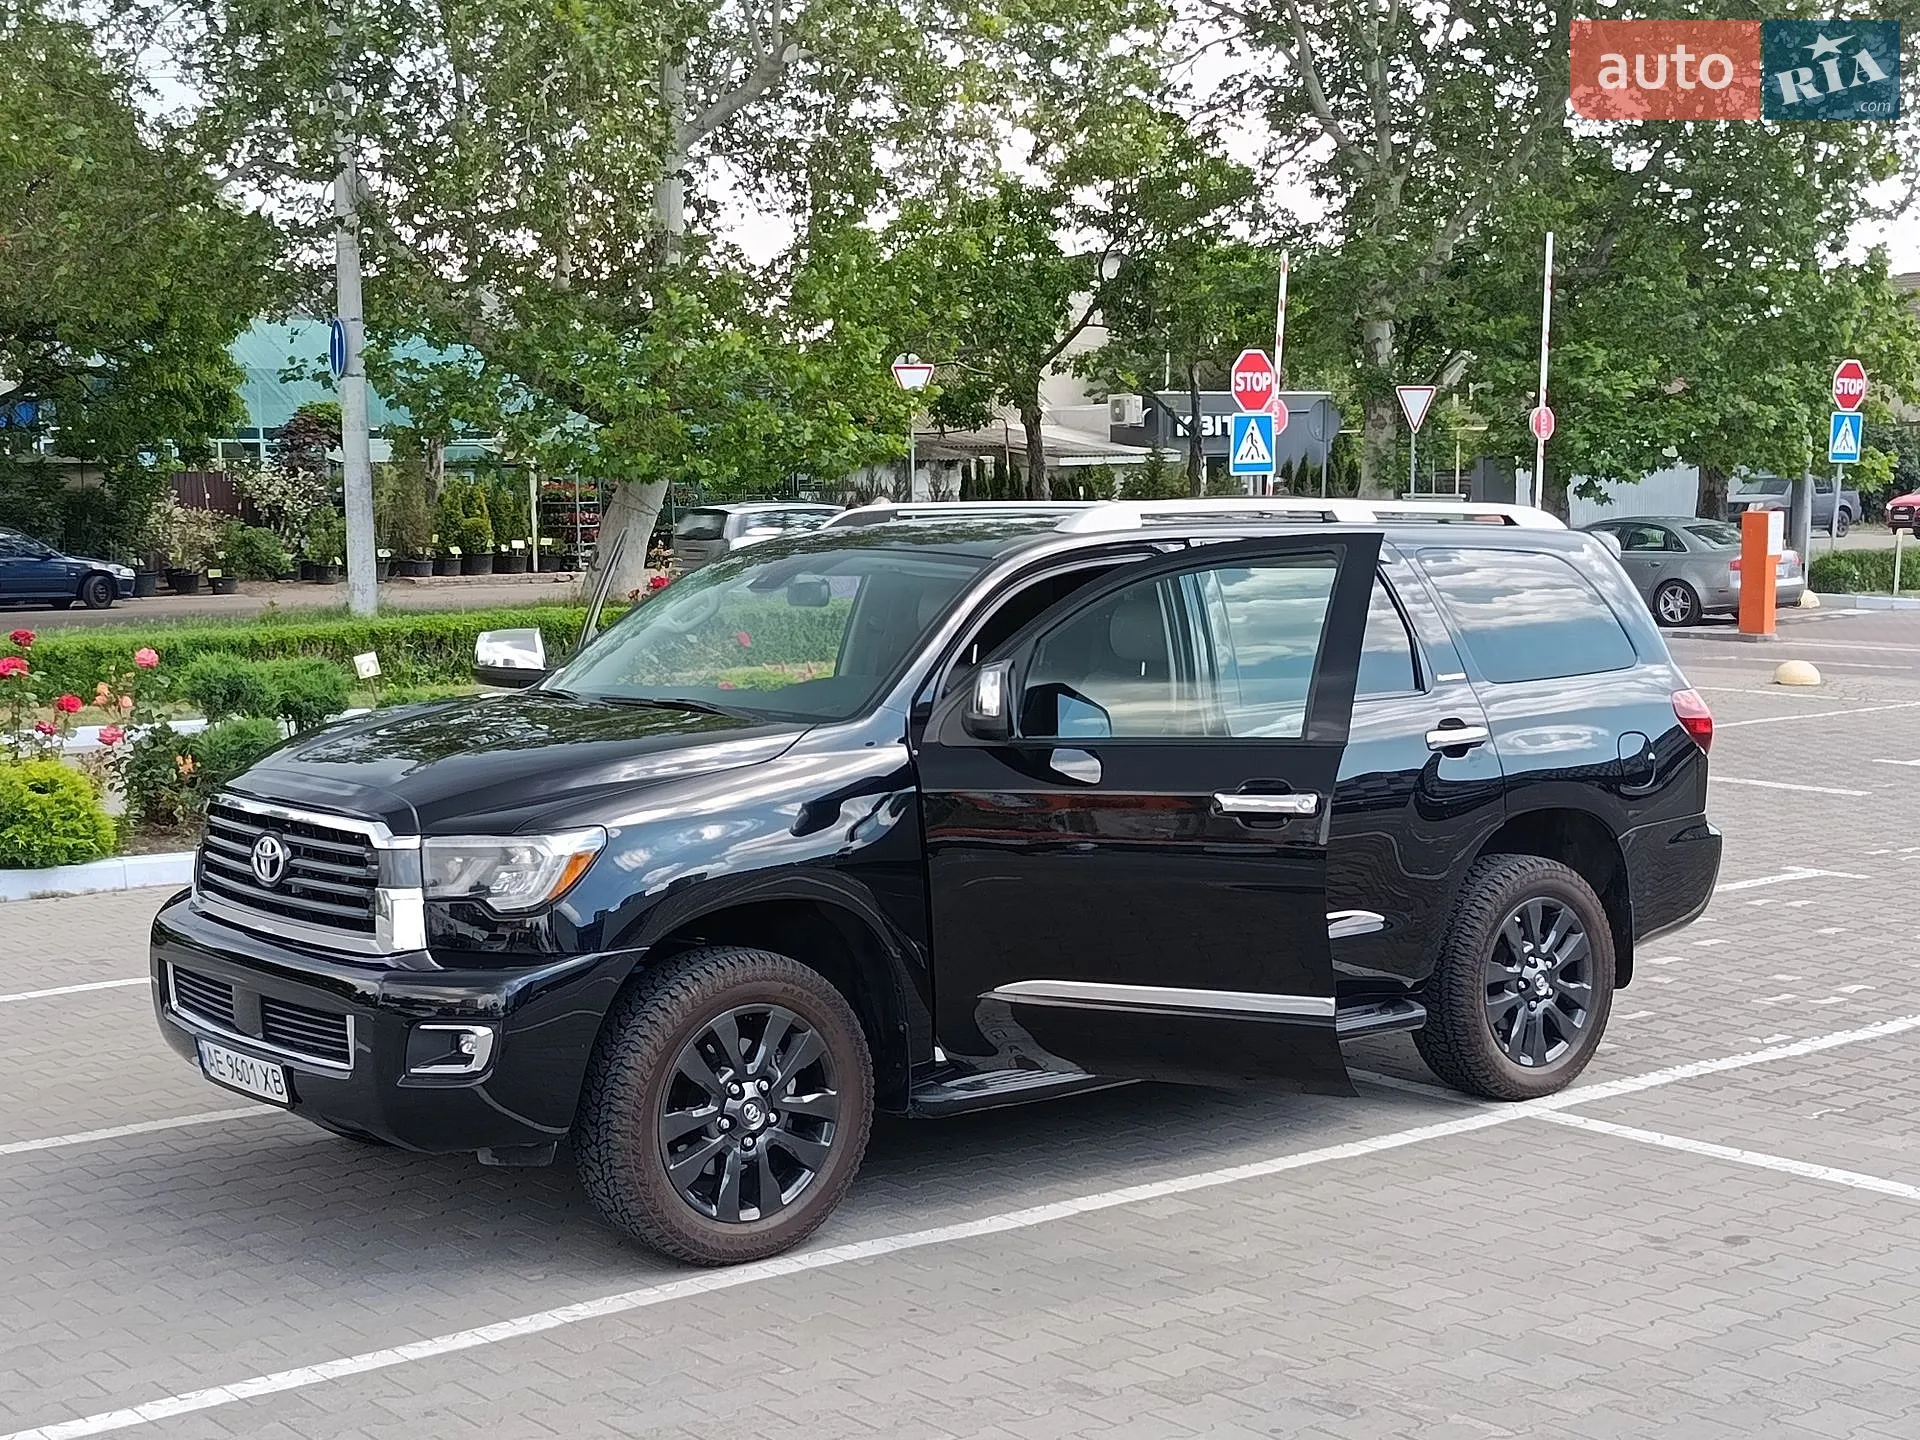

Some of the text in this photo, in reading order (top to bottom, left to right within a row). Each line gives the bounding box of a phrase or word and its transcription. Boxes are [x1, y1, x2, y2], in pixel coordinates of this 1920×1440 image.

[1235, 371, 1272, 392] STOP
[1835, 377, 1863, 395] STOP
[1176, 415, 1233, 437] КВІТ
[207, 1046, 284, 1096] AE 9601 XB
